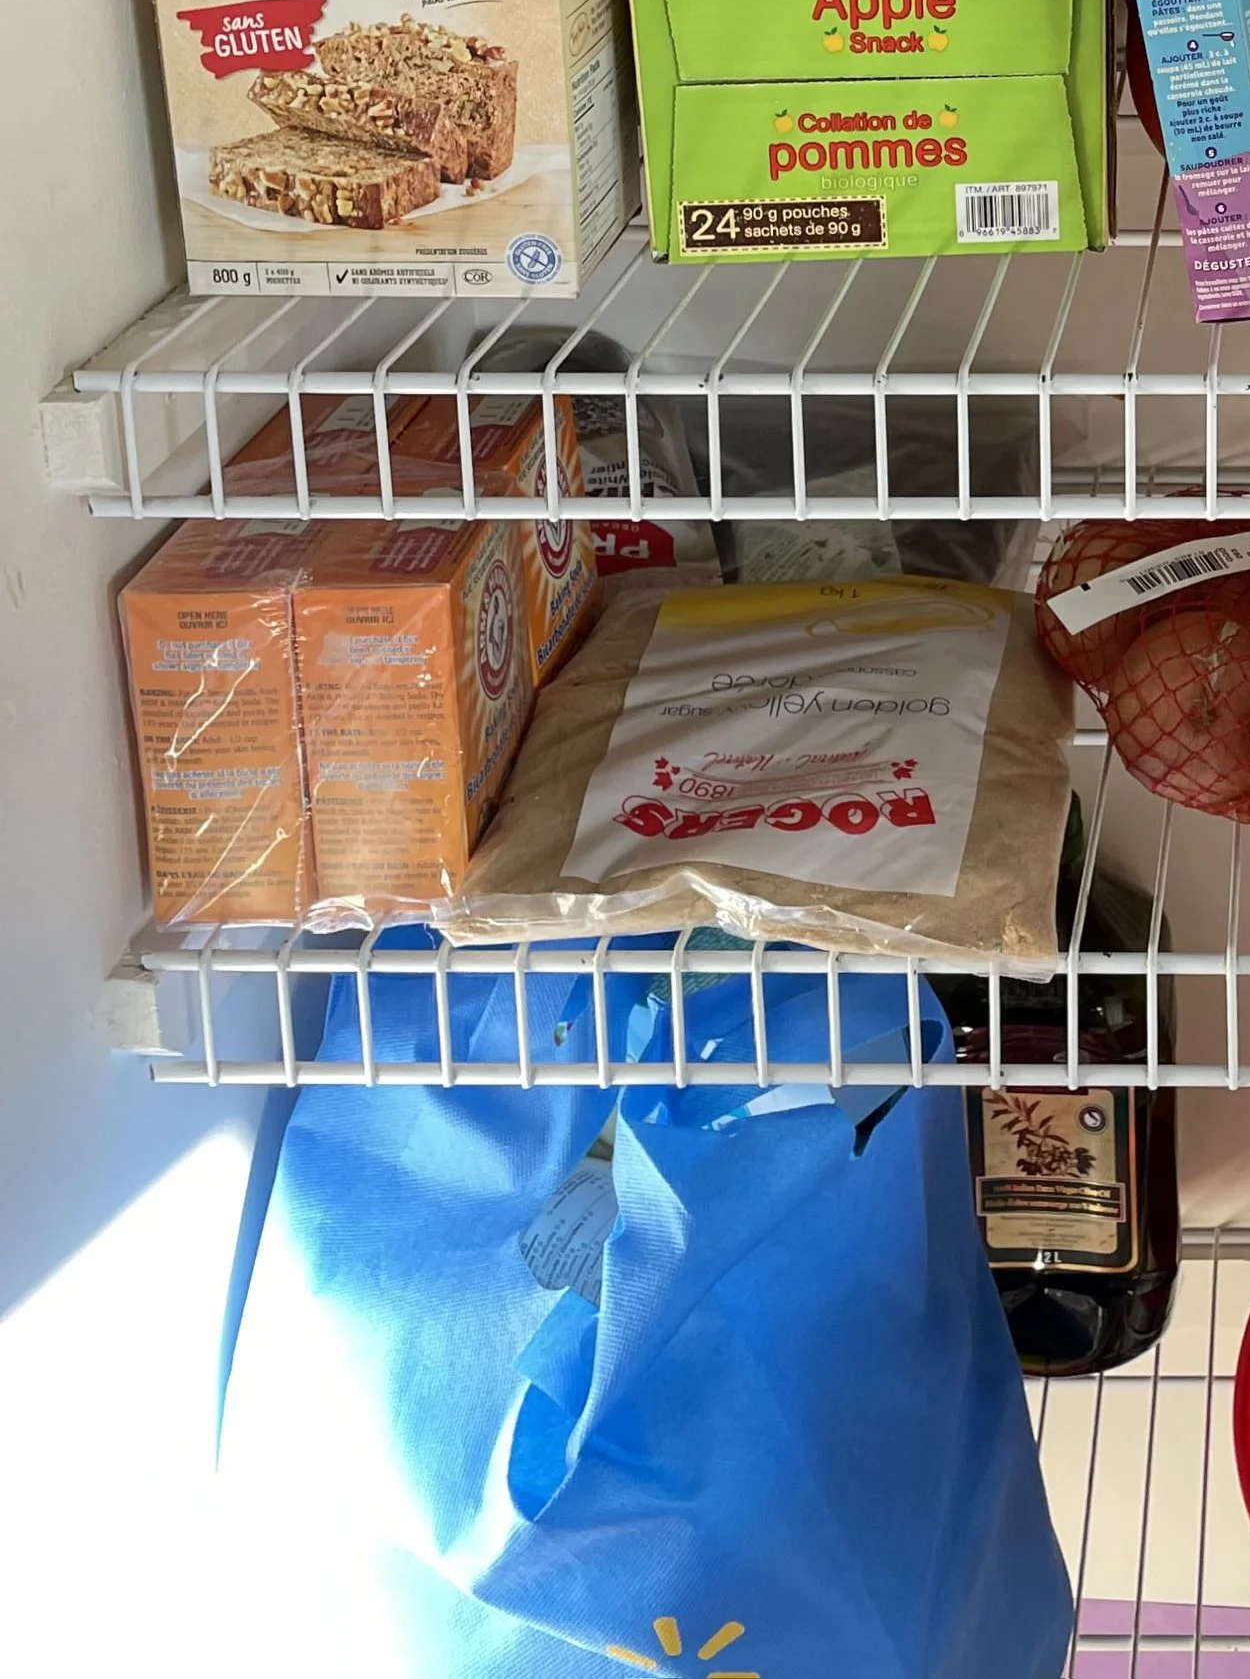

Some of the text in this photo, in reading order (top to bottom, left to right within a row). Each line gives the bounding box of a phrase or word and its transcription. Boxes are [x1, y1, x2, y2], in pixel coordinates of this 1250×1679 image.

[1152, 7, 1181, 18] PÂTES
[222, 13, 265, 32] sans
[214, 25, 303, 59] GLUTEN
[849, 30, 925, 54] Snack
[1161, 52, 1204, 64] AJOUTER
[797, 110, 933, 134] Collation de
[768, 136, 968, 182] pommes
[1179, 157, 1244, 172] SAUPOUDRER
[820, 172, 919, 192] biologique
[1014, 183, 1048, 193] 897971
[1222, 176, 1242, 188] pour
[742, 205, 848, 224] 90 g pouches
[690, 207, 741, 242] 24
[743, 221, 861, 239] sachets de 90 g
[1198, 232, 1235, 244] casserole
[213, 268, 252, 287] 800 g
[592, 533, 650, 560] PR
[549, 579, 571, 616] Baking
[819, 586, 860, 599] 1 kg
[710, 672, 814, 694] dorée
[659, 696, 951, 717] golden sugar
[678, 776, 735, 800] 1890
[612, 787, 937, 841] ROGERS
[1043, 1252, 1052, 1263] 2
